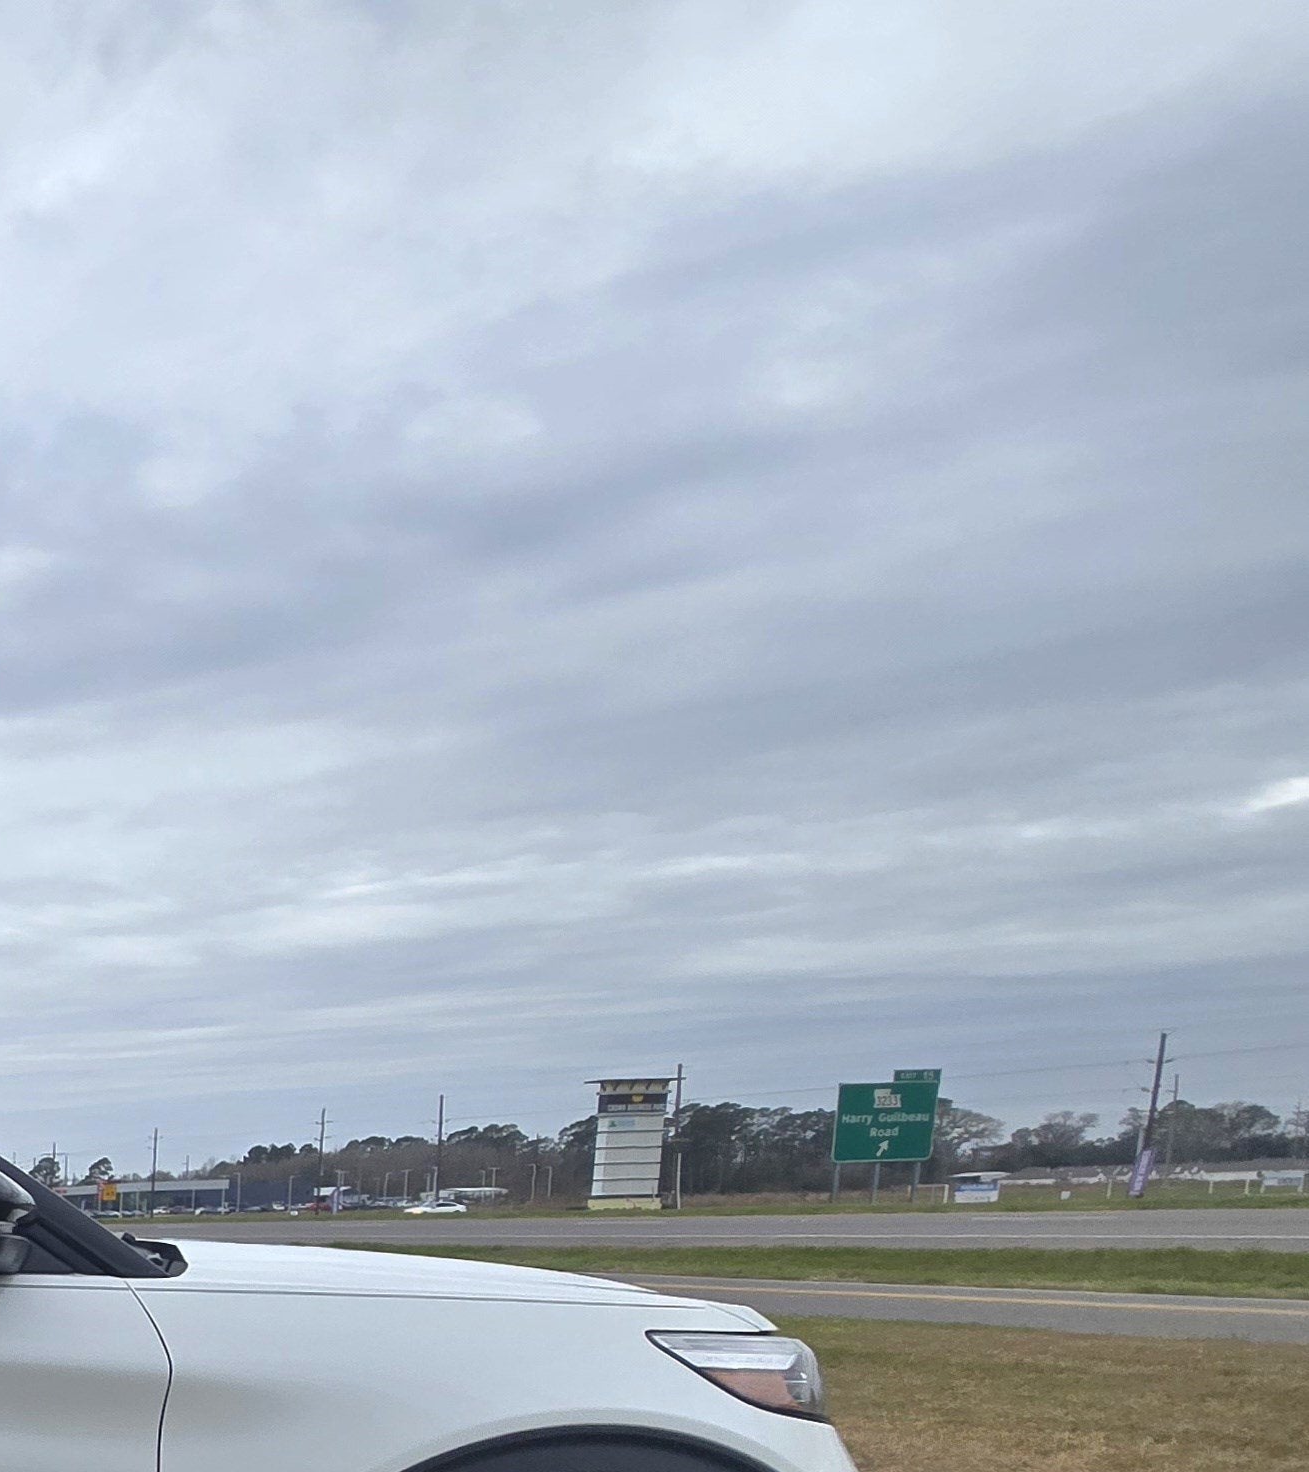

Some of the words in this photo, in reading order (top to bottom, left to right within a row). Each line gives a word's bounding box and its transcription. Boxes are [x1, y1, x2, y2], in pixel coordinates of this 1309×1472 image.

[841, 1114, 873, 1126] Harry
[878, 1111, 930, 1122] Guilbeau
[869, 1126, 900, 1137] Road
